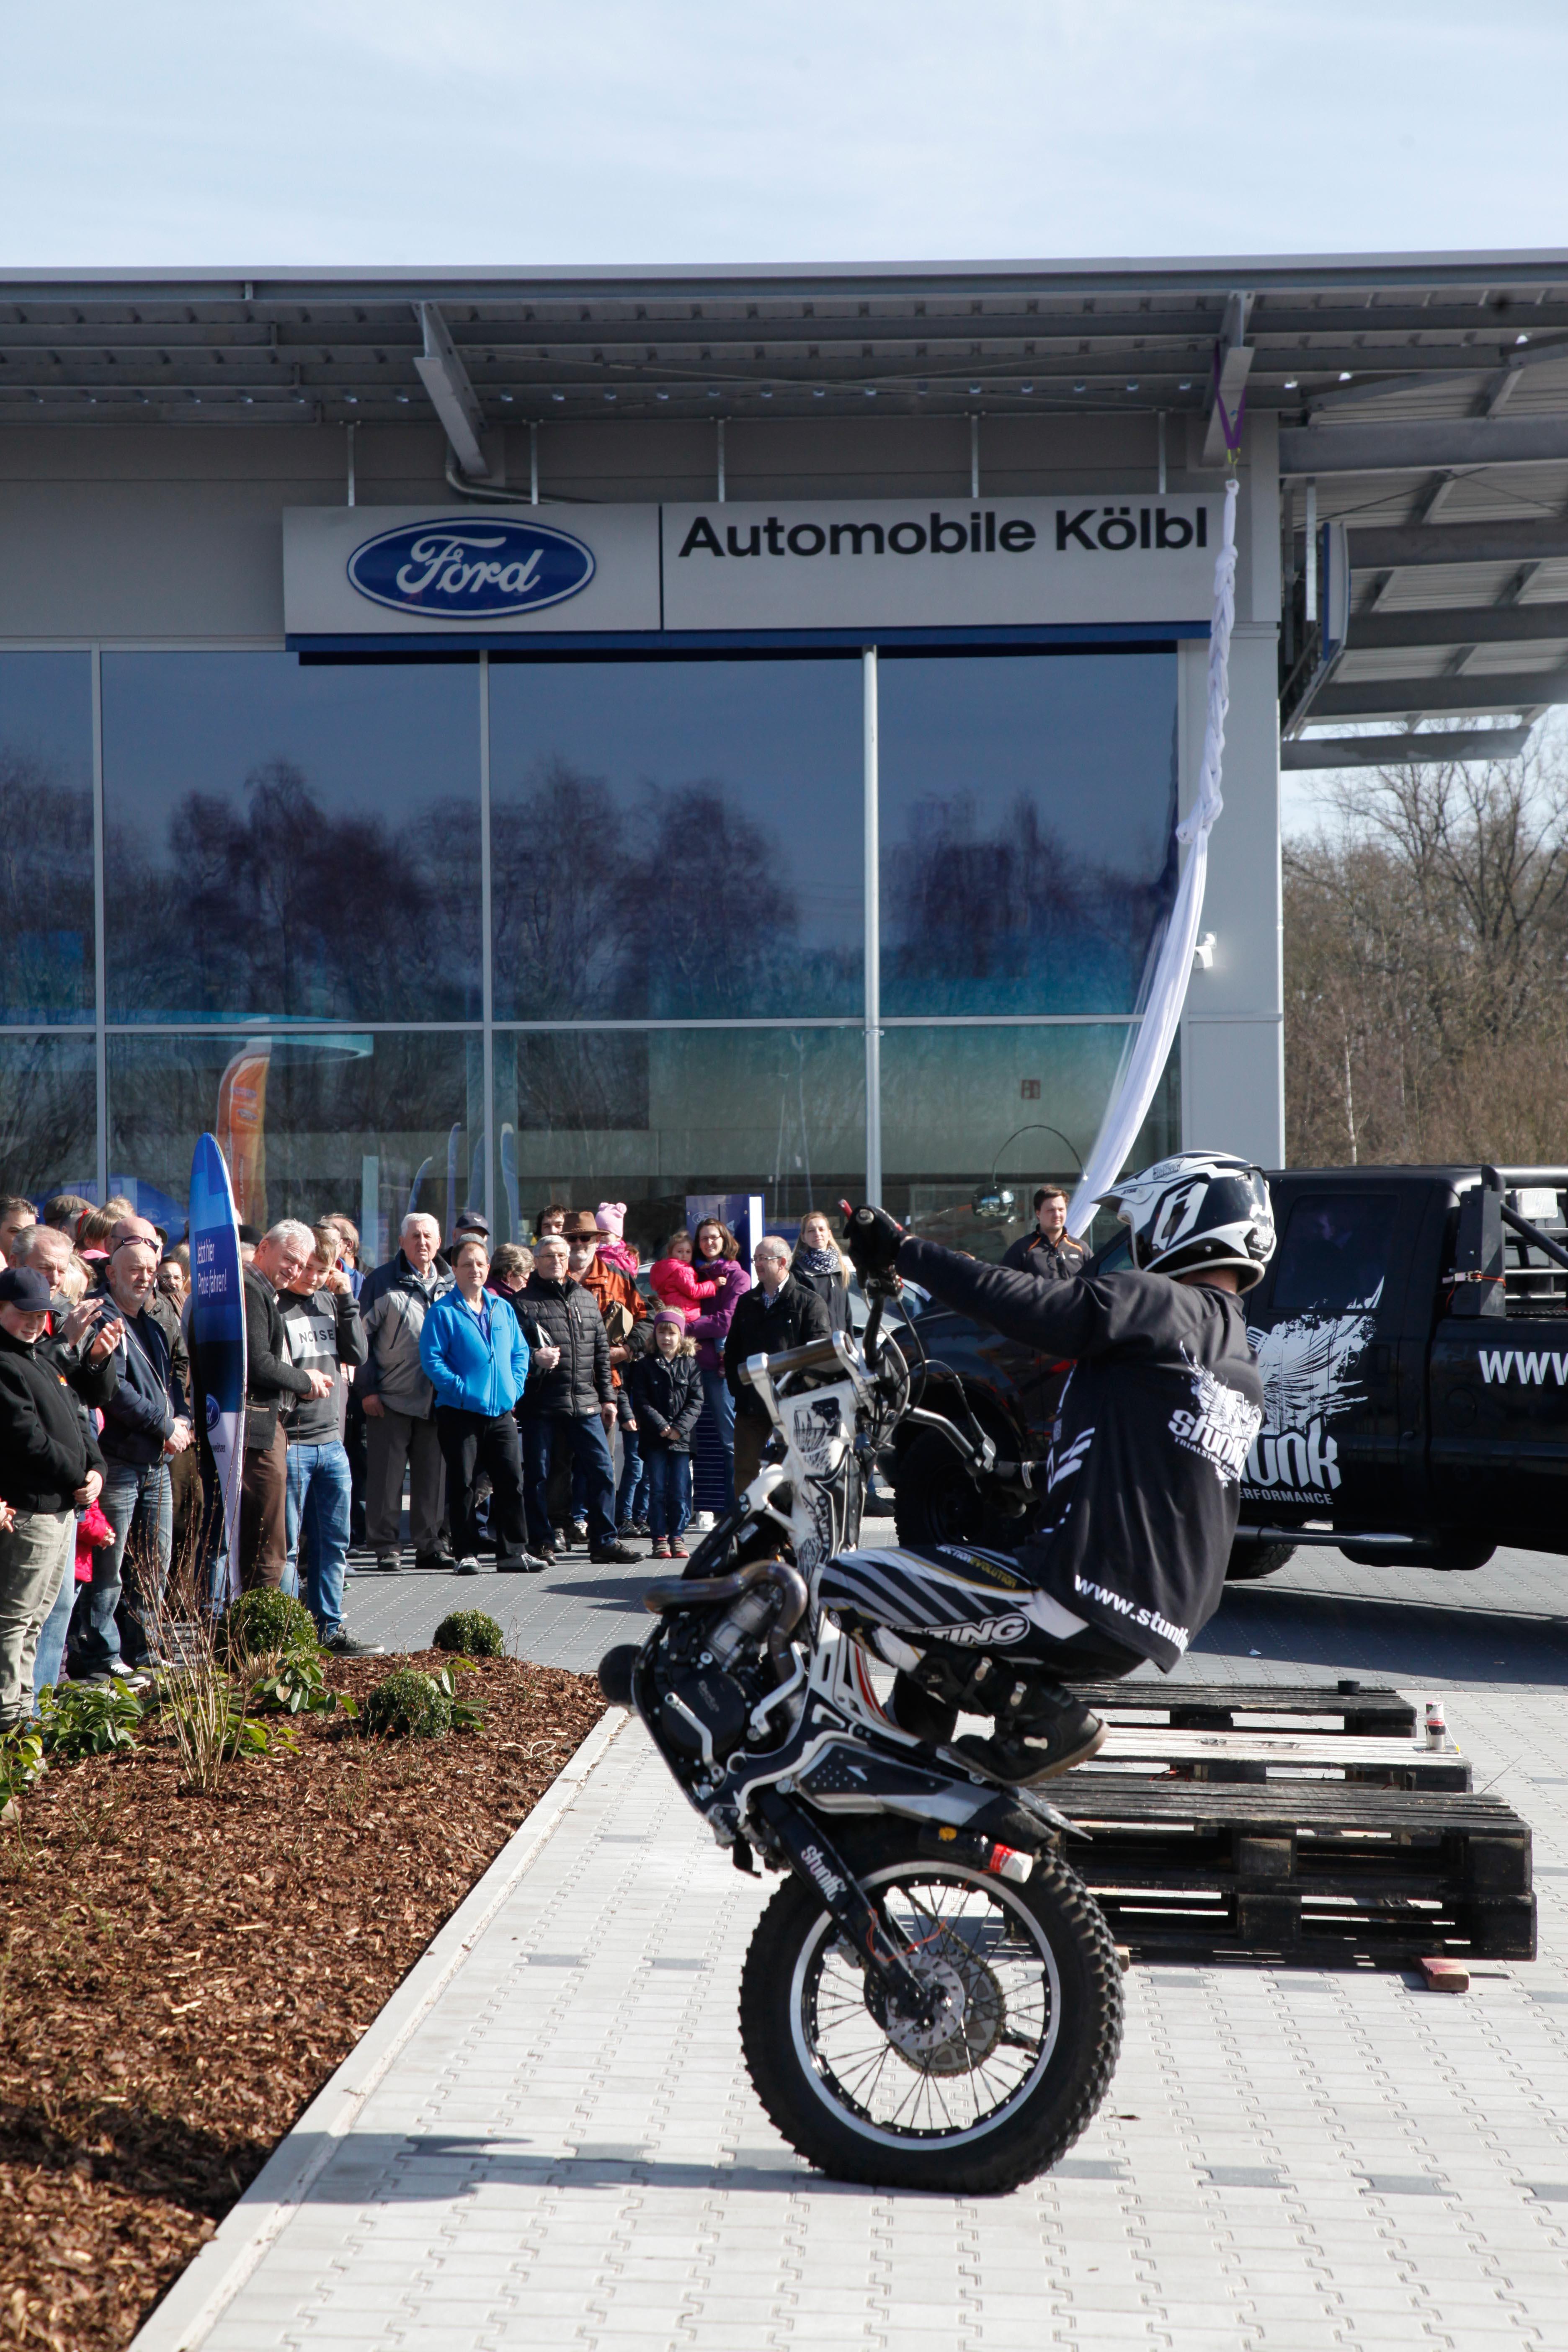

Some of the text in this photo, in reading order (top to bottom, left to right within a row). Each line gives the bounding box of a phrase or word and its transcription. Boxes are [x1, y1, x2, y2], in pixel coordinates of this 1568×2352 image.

[678, 507, 1207, 557] Automobile Kölbl
[397, 534, 544, 593] Ford
[197, 1238, 214, 1264] Jetzt hier
[198, 1268, 227, 1298] Probe fahren!
[299, 1329, 335, 1344] NOISE
[1240, 1488, 1333, 1504] ERFORMANCE
[927, 1615, 1027, 1643] TING
